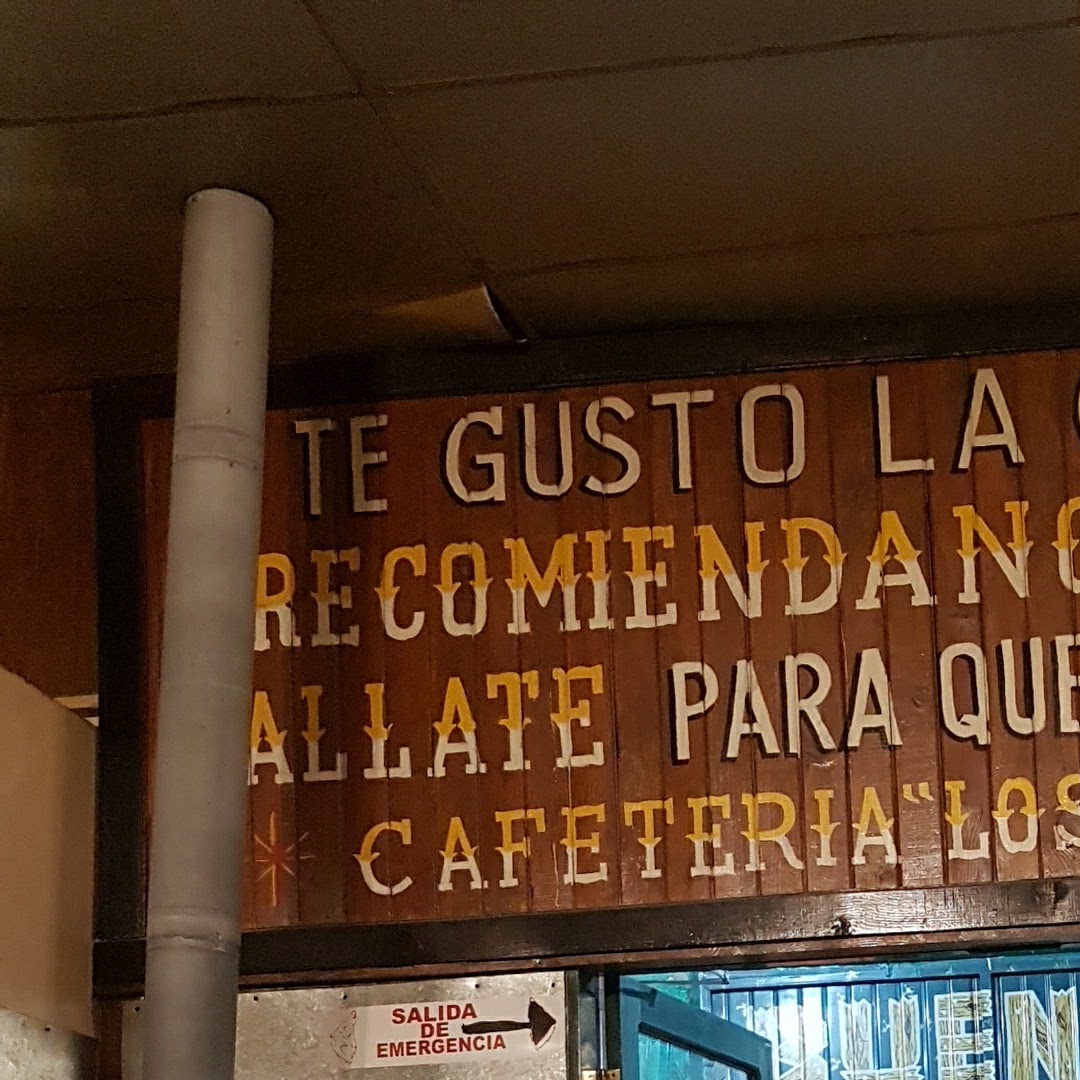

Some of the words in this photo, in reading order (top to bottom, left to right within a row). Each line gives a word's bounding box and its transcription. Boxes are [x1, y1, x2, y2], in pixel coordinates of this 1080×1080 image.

[295, 413, 389, 515] TE
[444, 383, 807, 505] GUSTO
[876, 367, 1026, 474] LA
[247, 663, 605, 785] ALLATE
[669, 646, 903, 764] PARA
[353, 786, 902, 896] CAFETERIA
[376, 1034, 507, 1059] EMERGENCIA
[392, 1003, 478, 1025] SALIDA
[420, 1022, 450, 1039] DE
